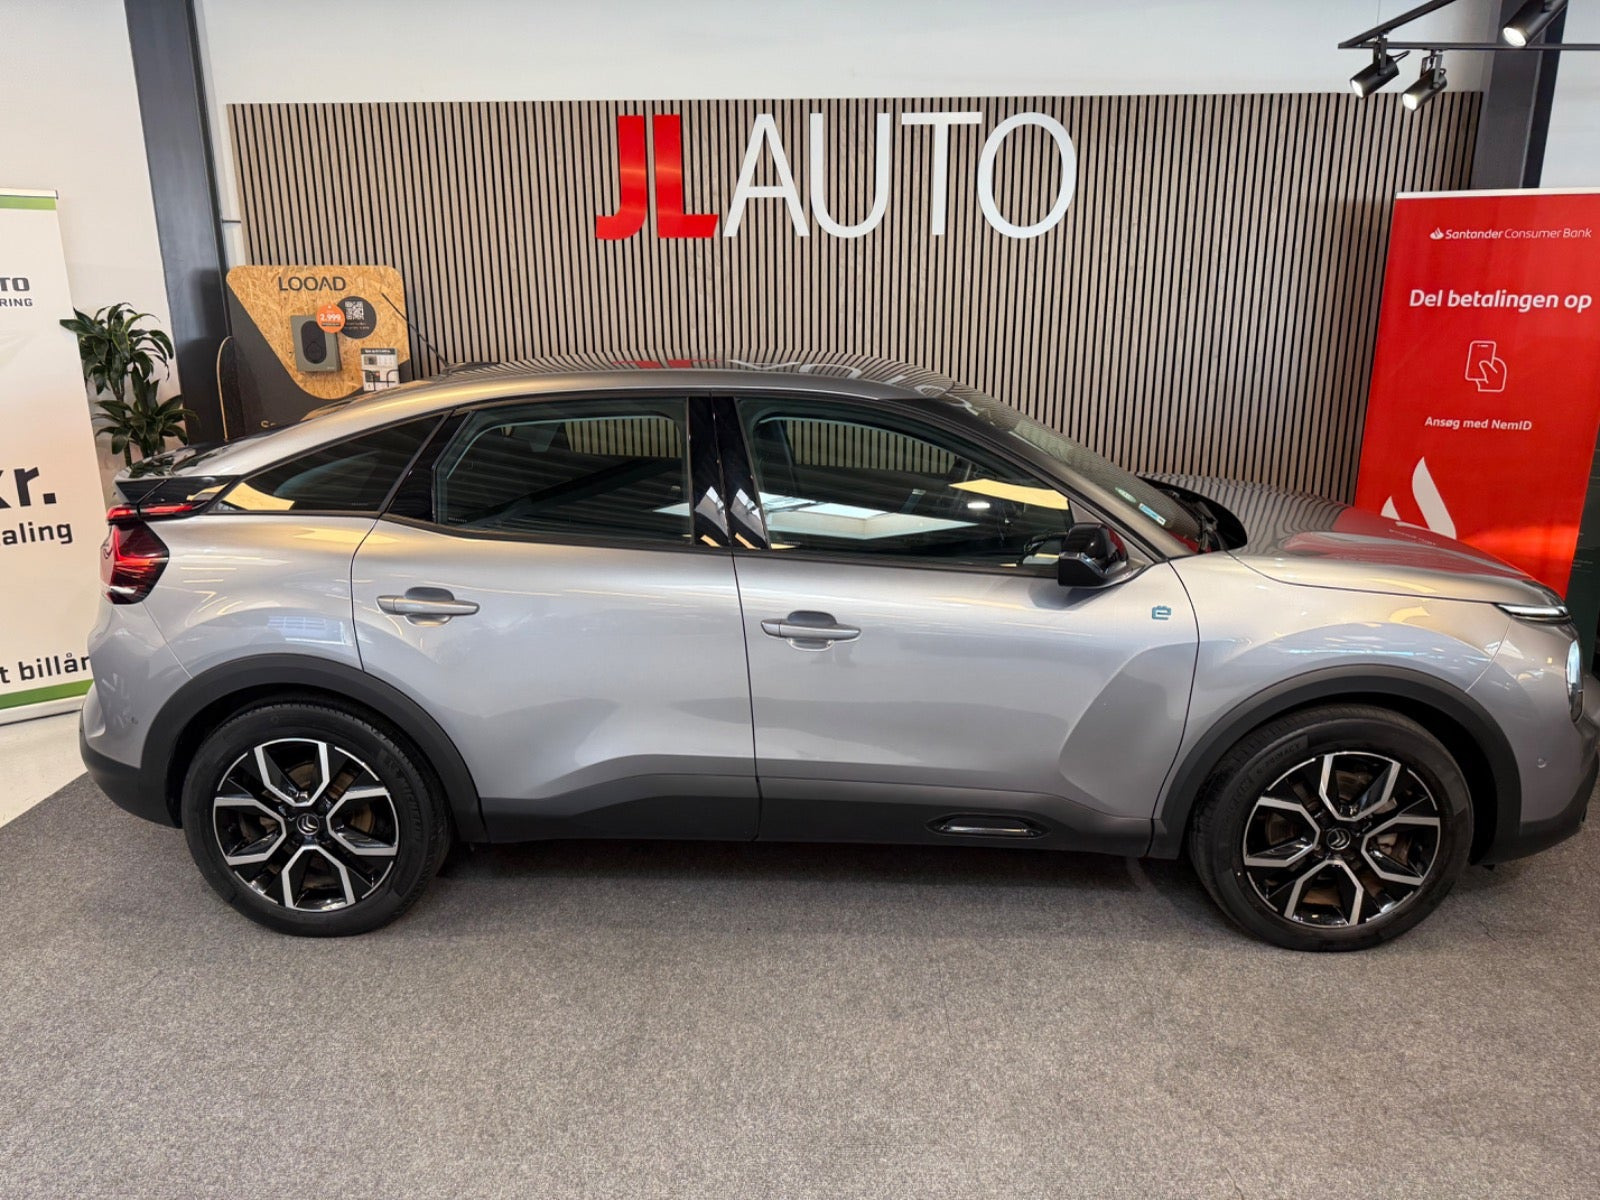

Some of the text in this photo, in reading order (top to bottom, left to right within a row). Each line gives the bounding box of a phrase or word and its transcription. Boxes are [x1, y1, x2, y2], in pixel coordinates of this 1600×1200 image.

[596, 112, 1077, 240] JL AUTO
[1445, 228, 1592, 239] Santander Consumer Bank
[0, 277, 30, 291] TO
[278, 276, 346, 291] LOOAD
[1409, 289, 1592, 313] Del betalingen op
[1425, 416, 1532, 431] Ansøg med NemID
